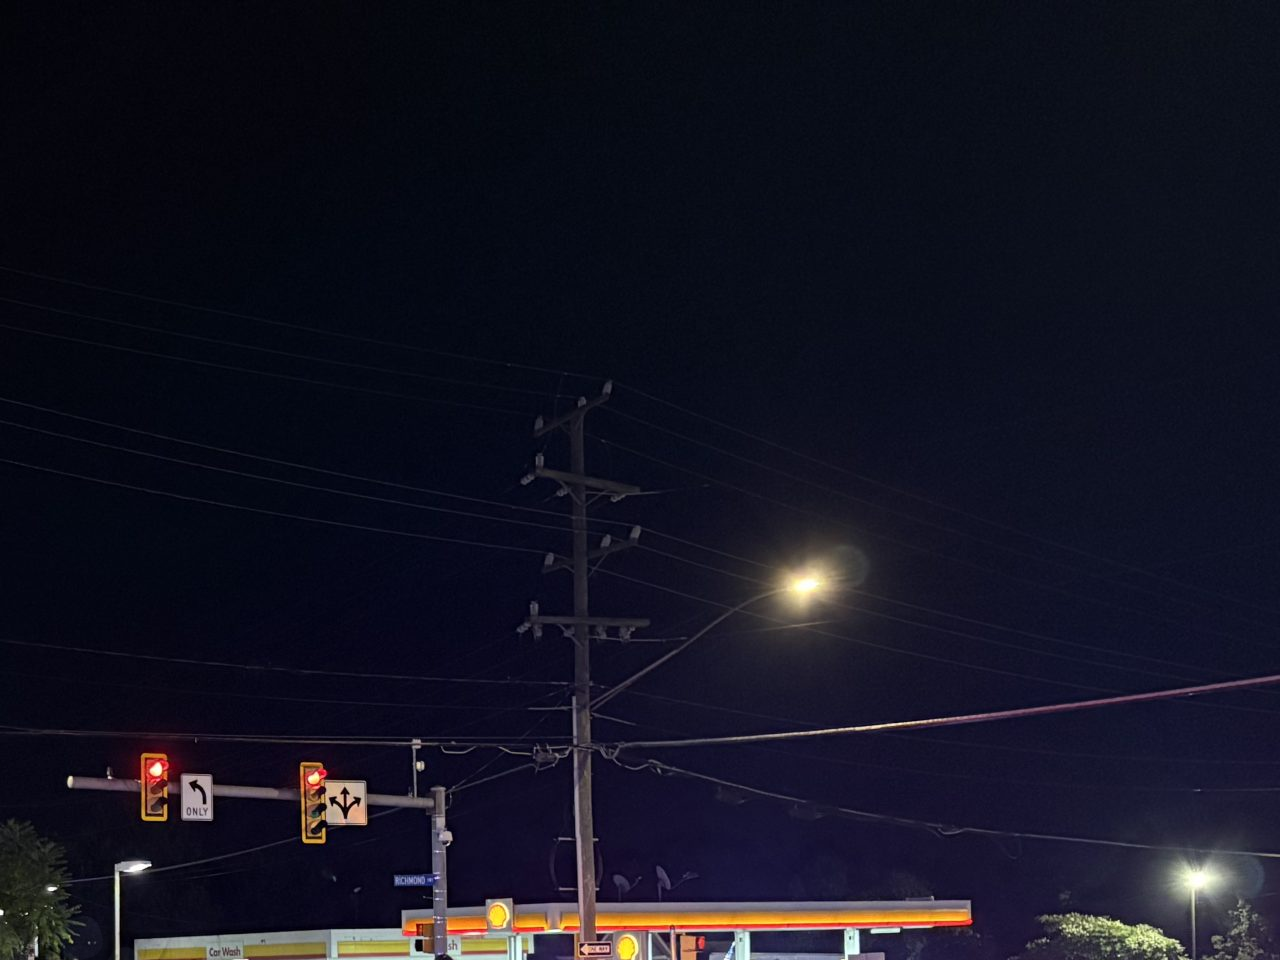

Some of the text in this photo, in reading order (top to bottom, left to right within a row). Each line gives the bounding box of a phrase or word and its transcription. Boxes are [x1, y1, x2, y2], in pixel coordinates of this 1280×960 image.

[186, 806, 209, 816] ONLY
[394, 875, 426, 886] RICHMOND
[209, 945, 241, 957] Car Wash
